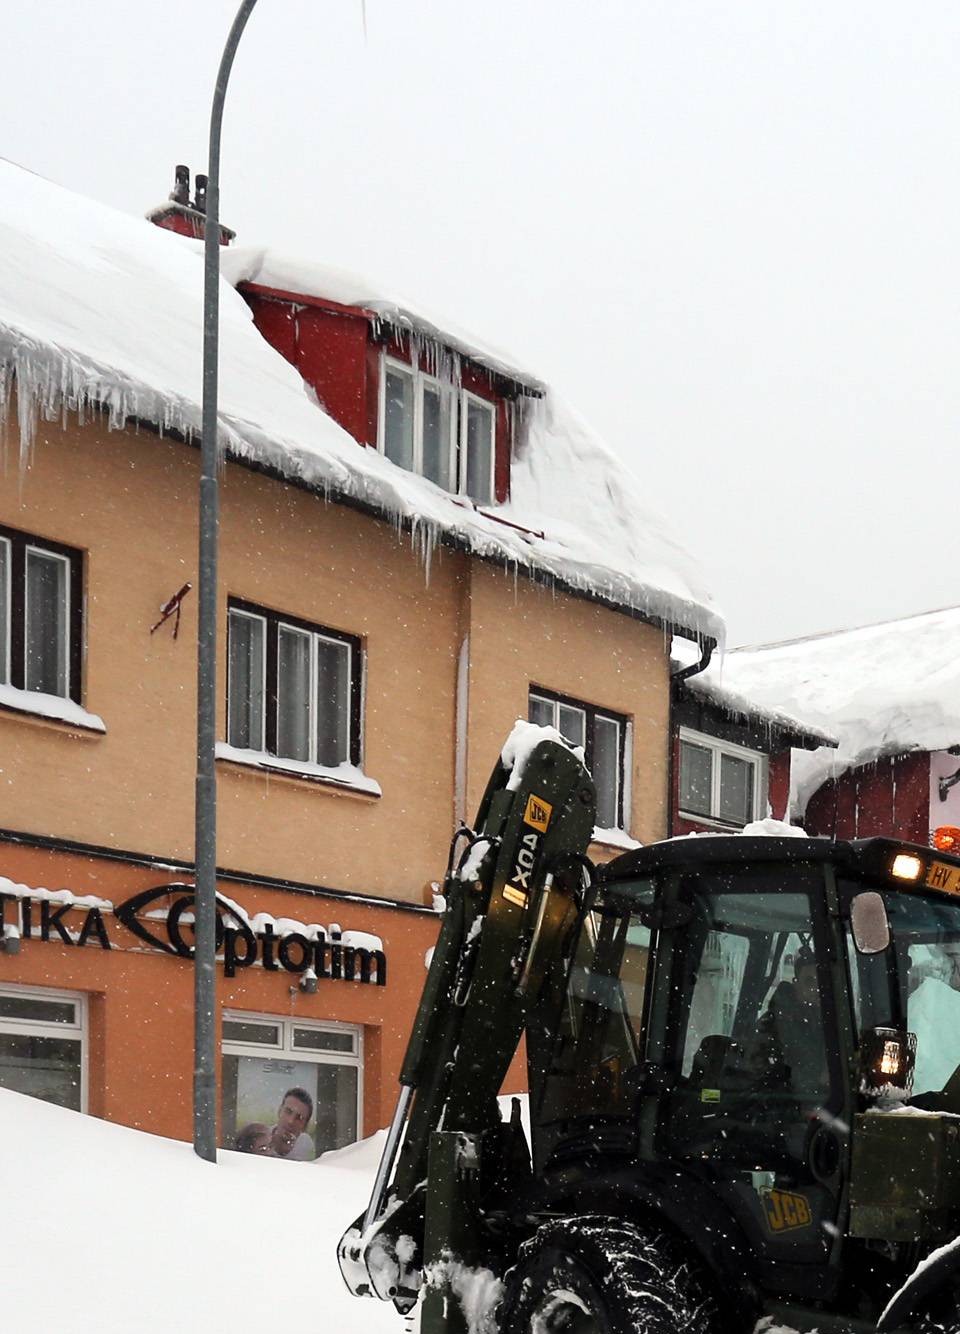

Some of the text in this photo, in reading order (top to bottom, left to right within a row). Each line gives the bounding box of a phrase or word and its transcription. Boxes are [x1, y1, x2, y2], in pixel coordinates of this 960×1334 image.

[530, 800, 547, 824] JCB
[932, 866, 953, 888] HV
[769, 1192, 809, 1229] JCB
